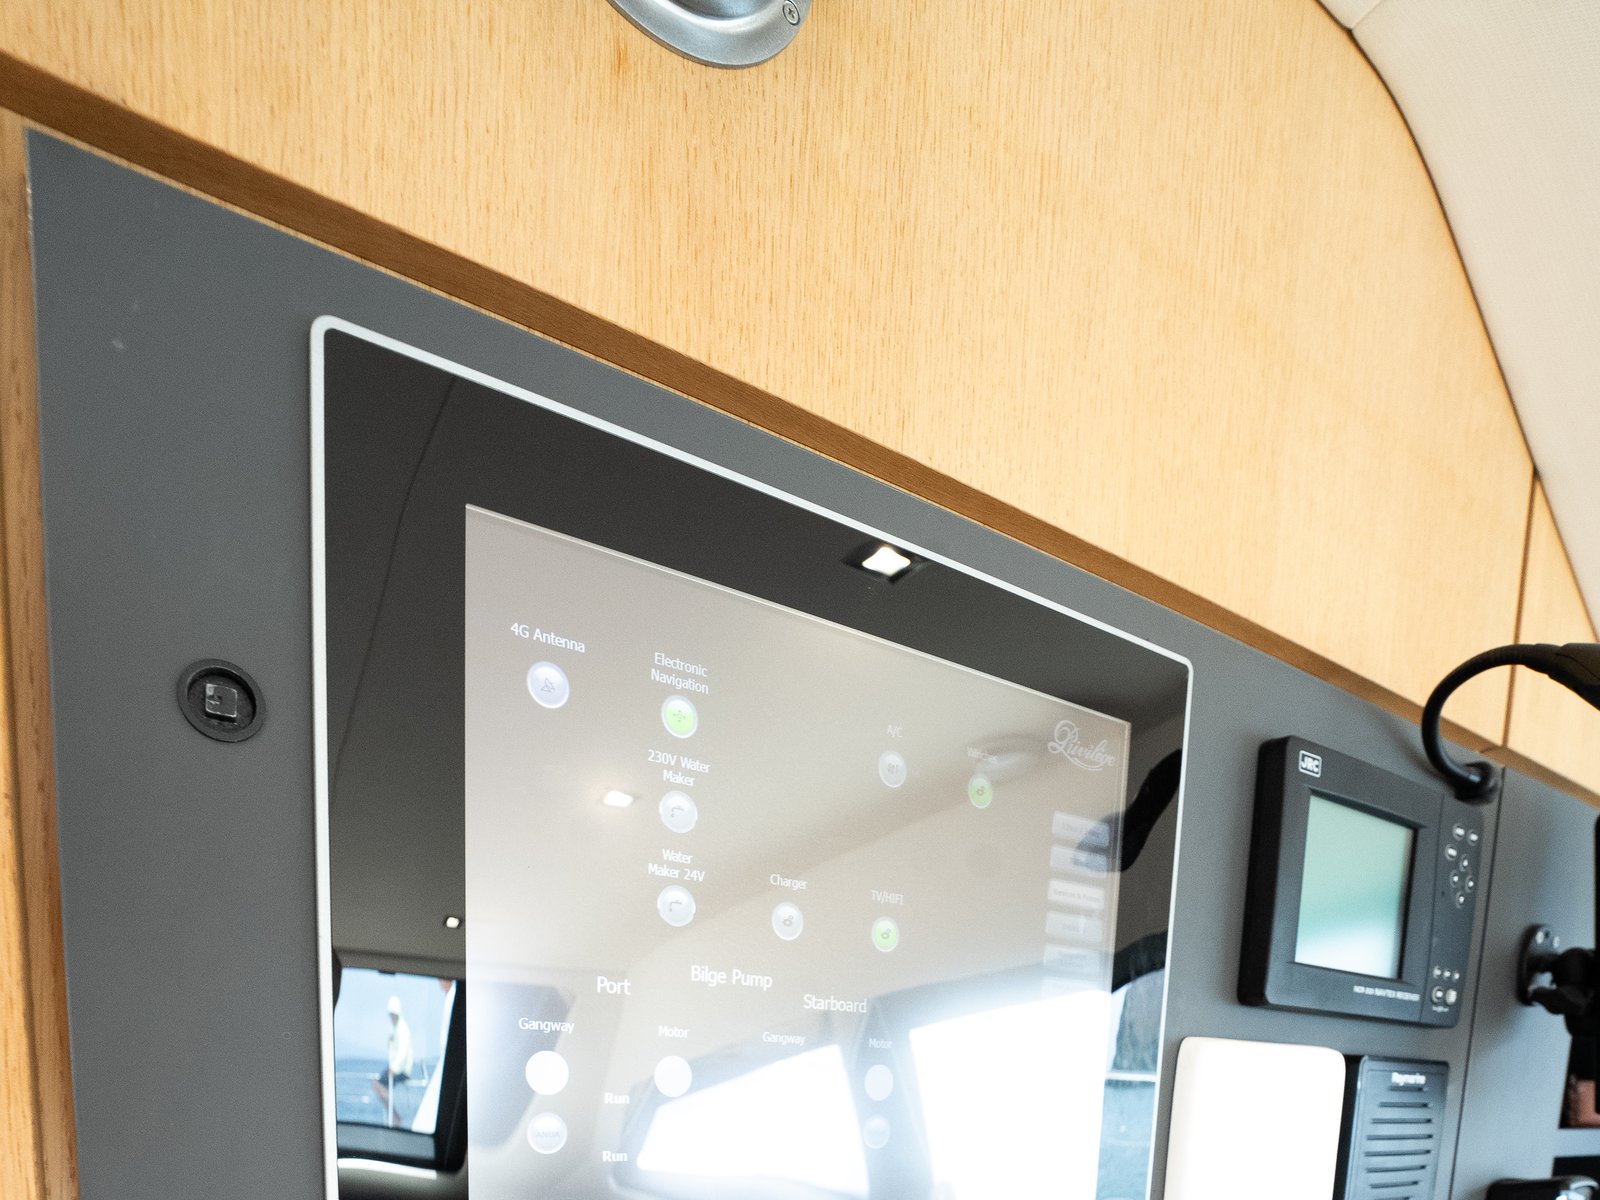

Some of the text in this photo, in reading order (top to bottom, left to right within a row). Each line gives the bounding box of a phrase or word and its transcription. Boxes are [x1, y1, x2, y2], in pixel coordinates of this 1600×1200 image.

[510, 622, 586, 653] 4G Antenna
[654, 652, 708, 677] Electronic
[650, 668, 709, 694] Navigation
[886, 724, 903, 738] A/C
[647, 749, 711, 774] 230V Water
[1301, 756, 1320, 773] JRC
[662, 770, 695, 786] Maker
[662, 848, 693, 864] Water
[648, 862, 705, 882] Maker 24V
[770, 874, 808, 890] Charger
[596, 974, 631, 996] Port
[690, 964, 773, 992] Bilge Pump
[803, 994, 868, 1014] Starboard
[518, 1017, 575, 1034] Gangway
[658, 1024, 690, 1040] Motor
[762, 1030, 806, 1047] Gangway
[868, 1037, 893, 1049] Motor
[604, 1092, 630, 1105] Run
[602, 1150, 628, 1162] Run
